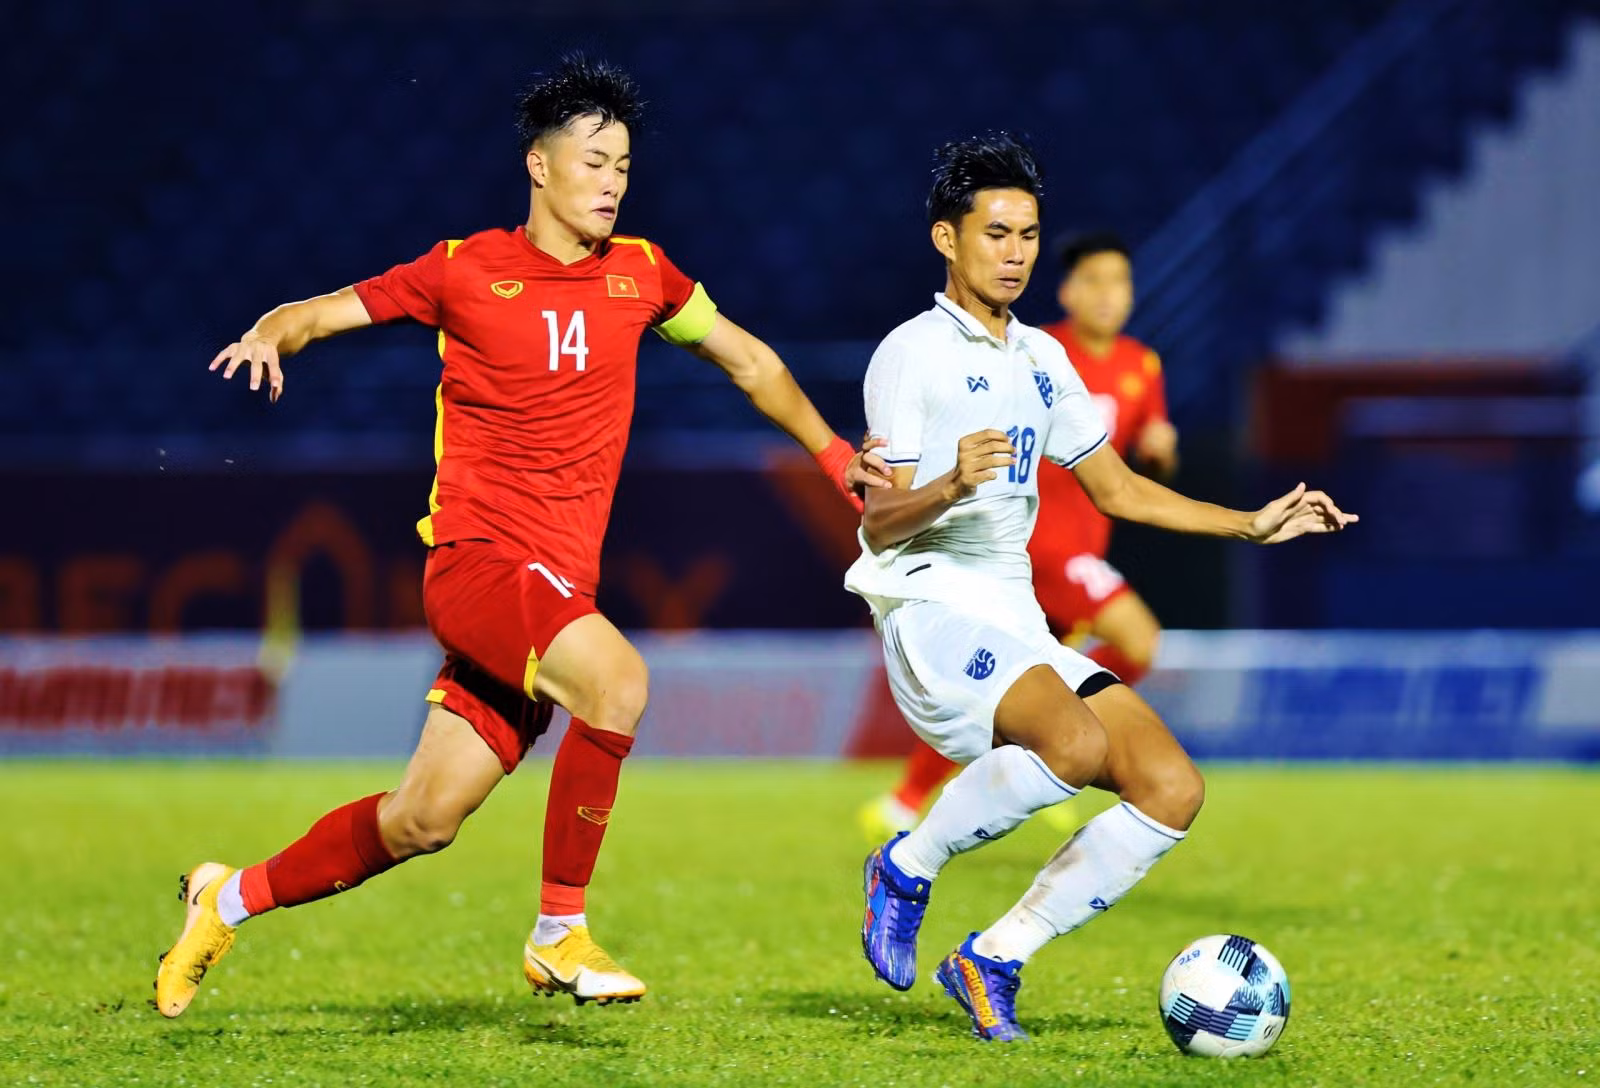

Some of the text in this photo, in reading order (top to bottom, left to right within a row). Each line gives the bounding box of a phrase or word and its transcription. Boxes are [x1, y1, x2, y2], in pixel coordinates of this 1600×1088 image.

[541, 309, 590, 372] 14
[1005, 425, 1036, 485] 18
[526, 561, 577, 599] 1
